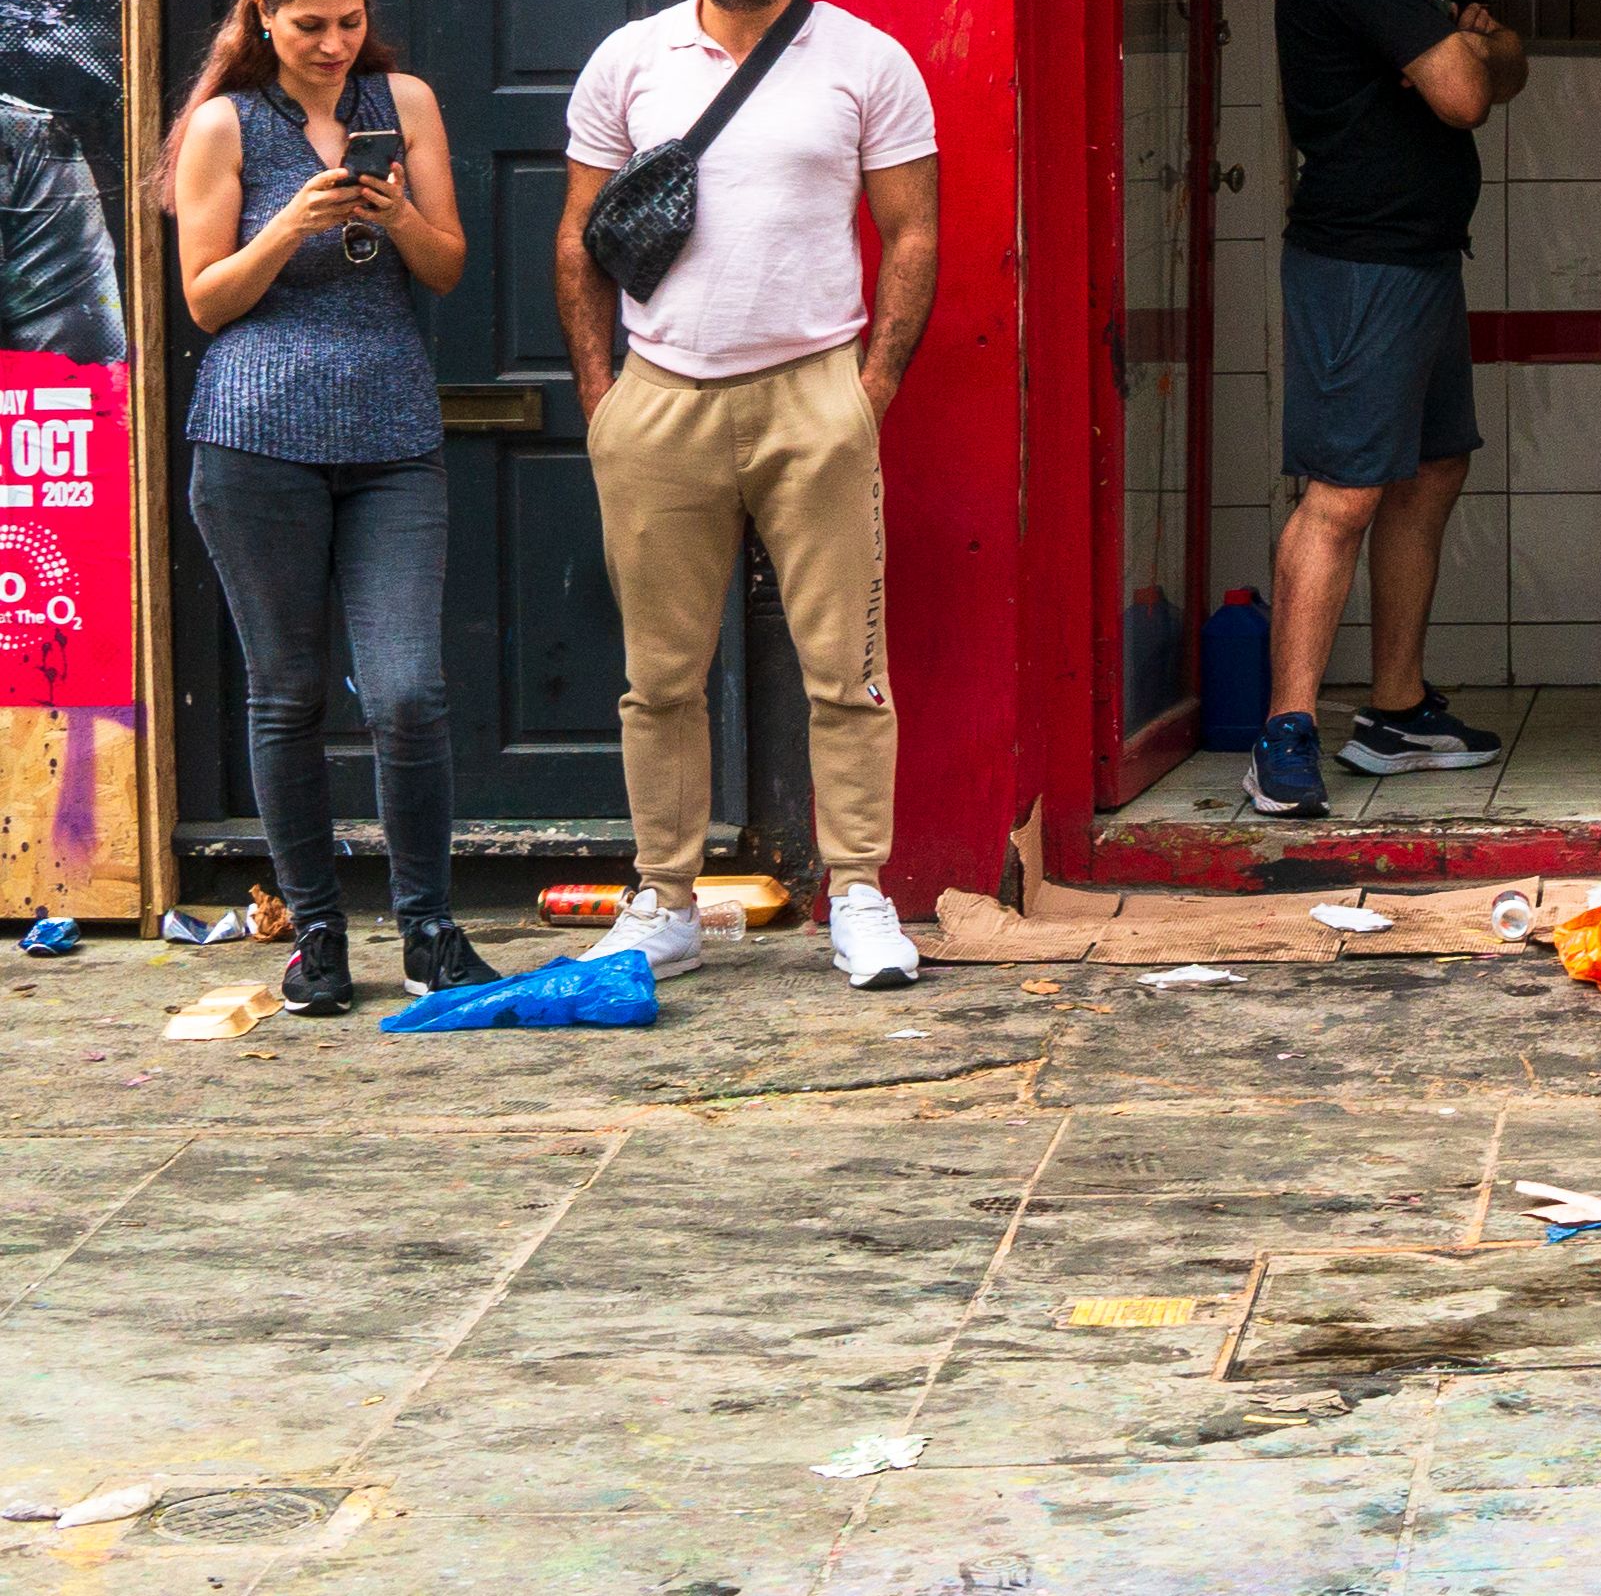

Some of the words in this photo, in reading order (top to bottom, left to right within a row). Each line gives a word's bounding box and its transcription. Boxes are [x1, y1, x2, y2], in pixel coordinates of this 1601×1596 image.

[11, 419, 94, 477] OCT
[42, 482, 94, 507] 2023
[871, 464, 884, 562] TOMMY
[15, 609, 46, 624] The
[862, 577, 883, 684] HILFIGER
